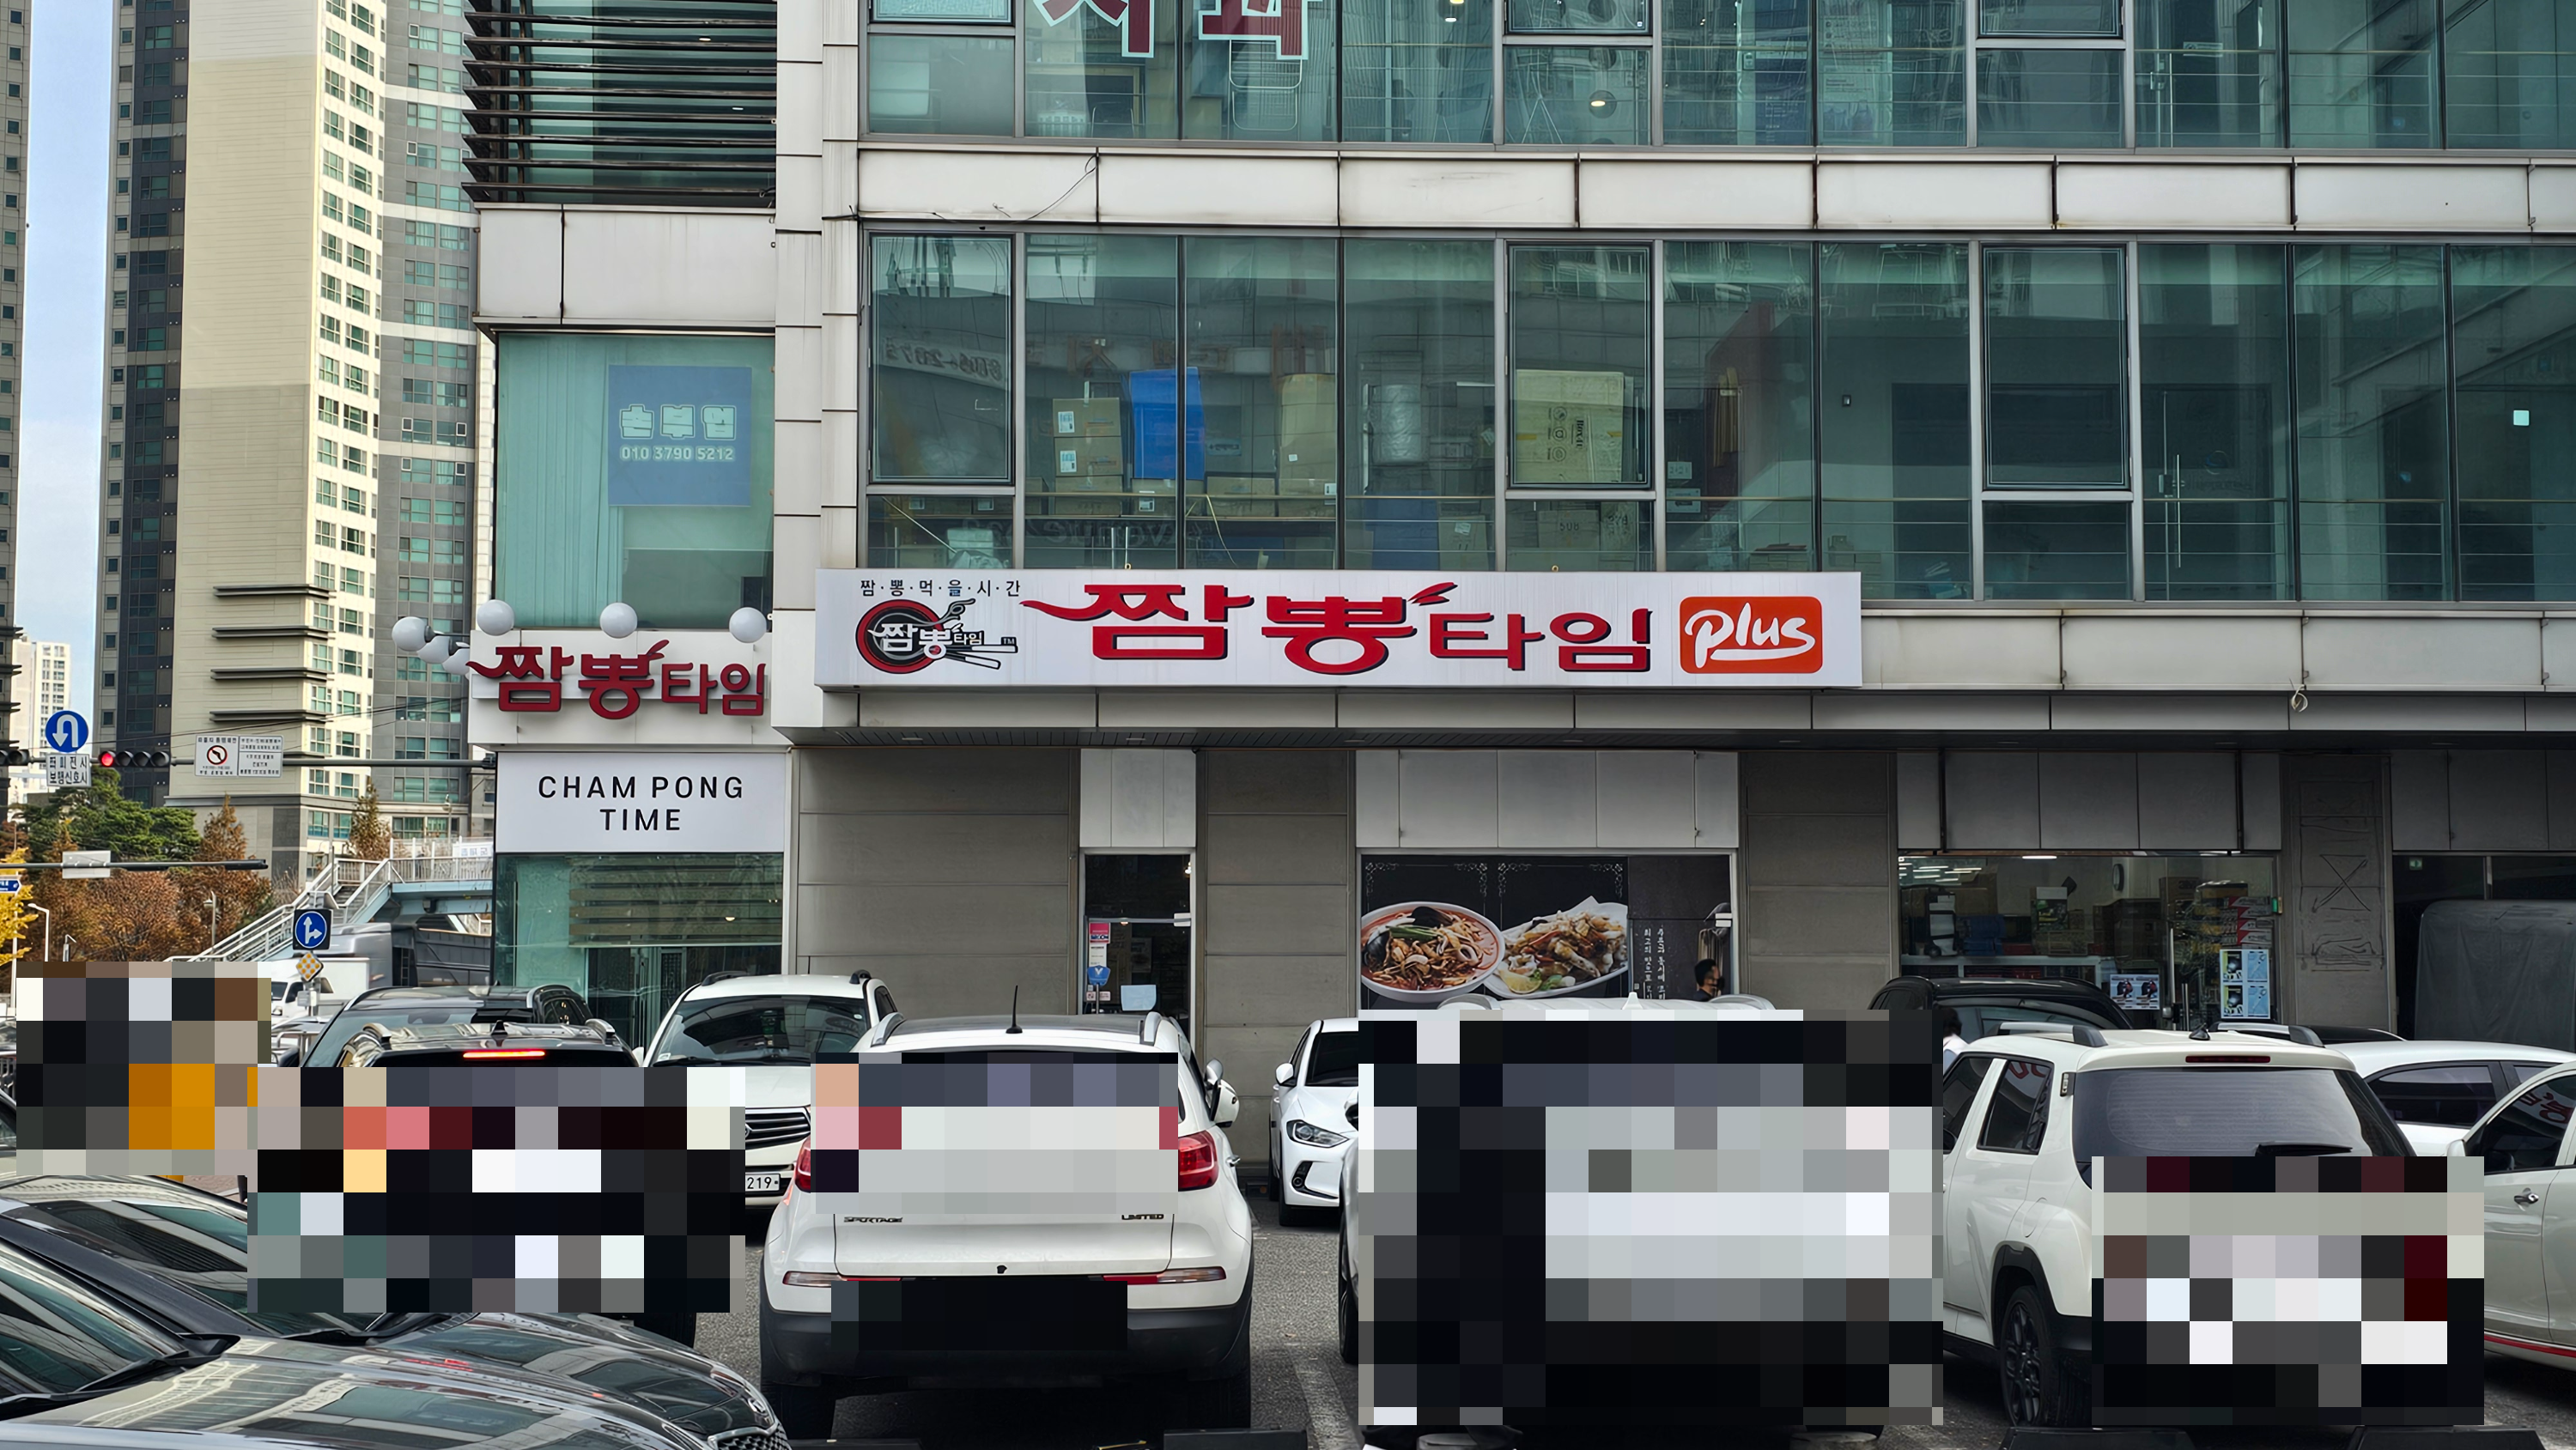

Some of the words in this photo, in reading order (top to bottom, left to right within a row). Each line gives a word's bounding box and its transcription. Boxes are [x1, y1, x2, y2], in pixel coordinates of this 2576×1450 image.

[622, 446, 650, 459] 010
[654, 446, 692, 460] 3790
[697, 446, 733, 460] 5212
[1019, 581, 1653, 675] 짬뽕타임
[465, 640, 767, 720] 짬뽕타임
[538, 776, 635, 798] CHAM
[652, 776, 743, 798] PONG
[599, 809, 681, 831] TIME
